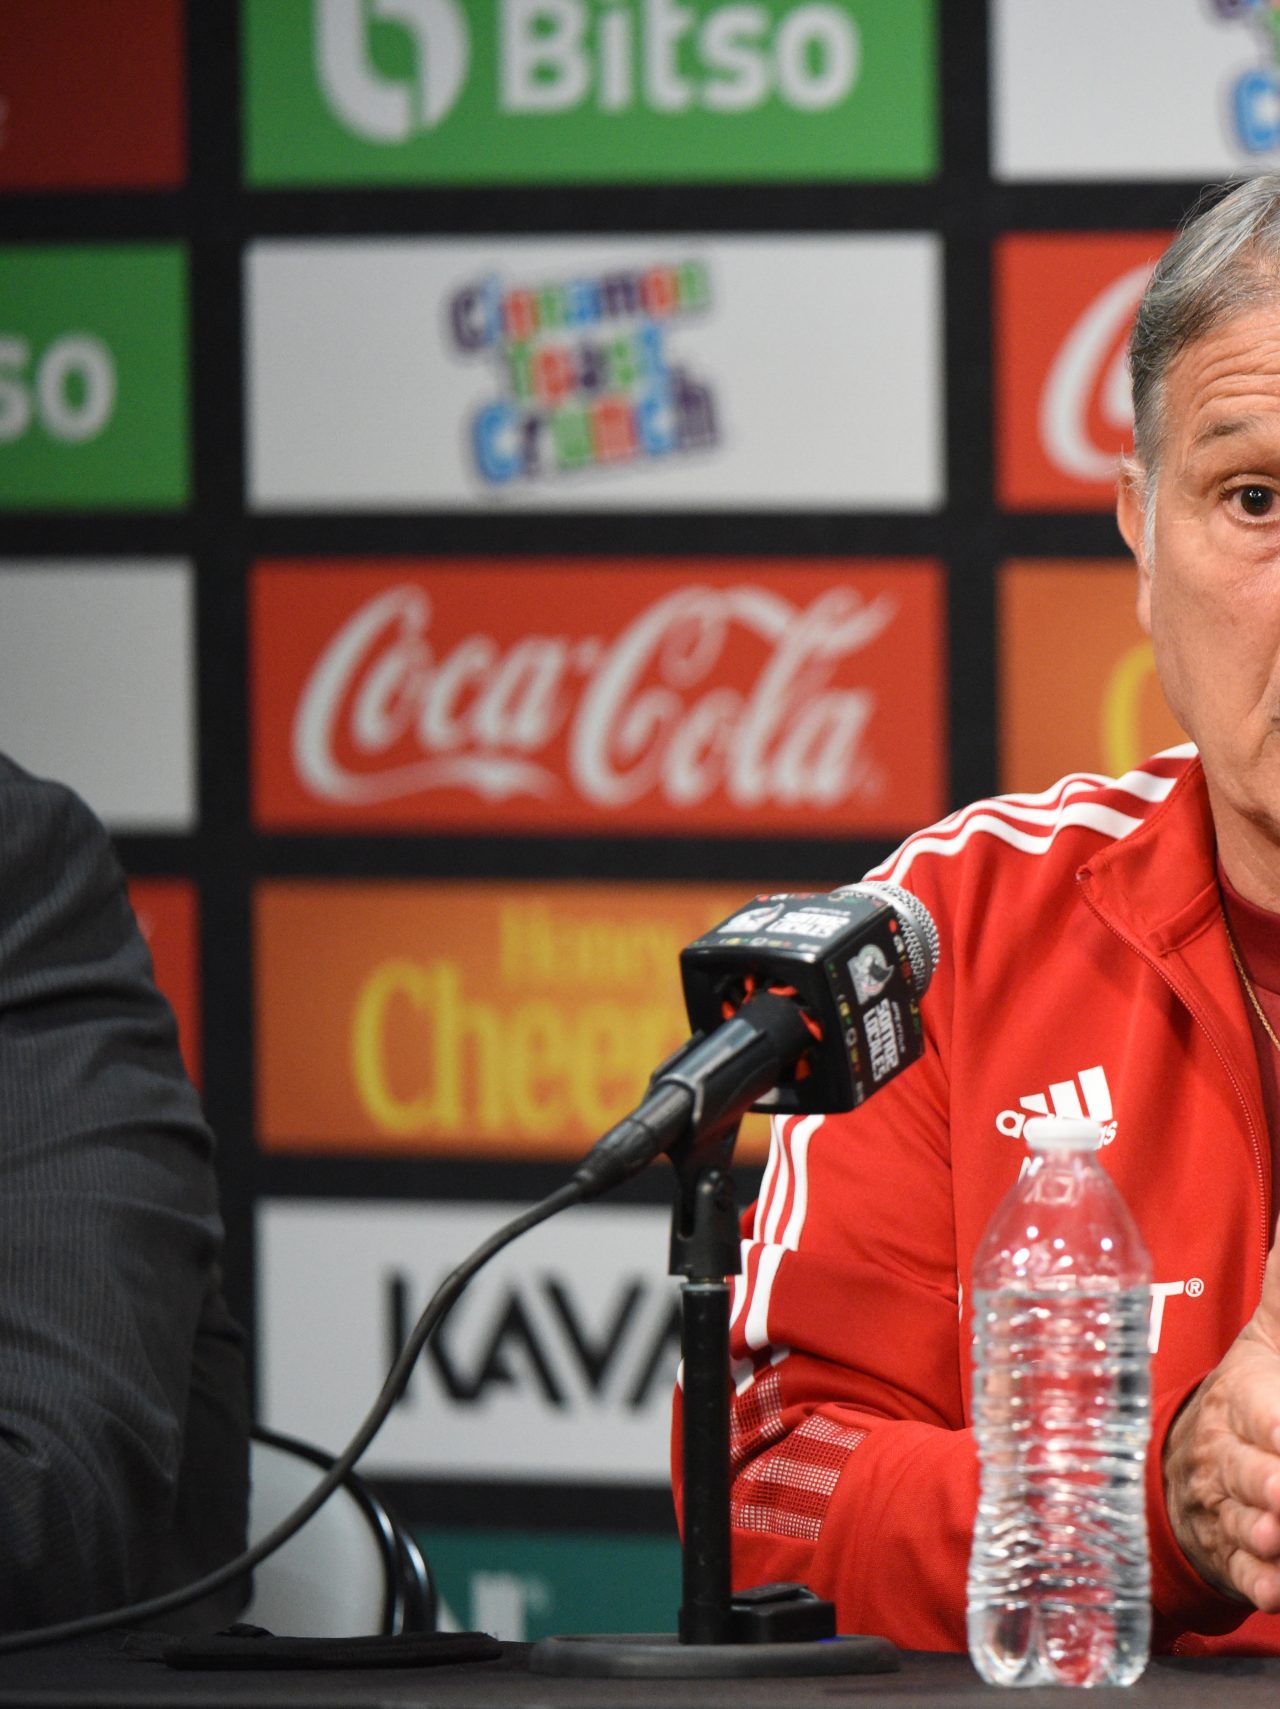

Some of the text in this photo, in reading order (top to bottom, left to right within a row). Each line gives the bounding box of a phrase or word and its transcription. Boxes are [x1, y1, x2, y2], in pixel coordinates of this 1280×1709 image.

[499, 0, 861, 113] Bitso
[445, 257, 714, 354] Cinnamon
[468, 366, 722, 485] Crunch
[291, 583, 896, 806] Coca-Cola
